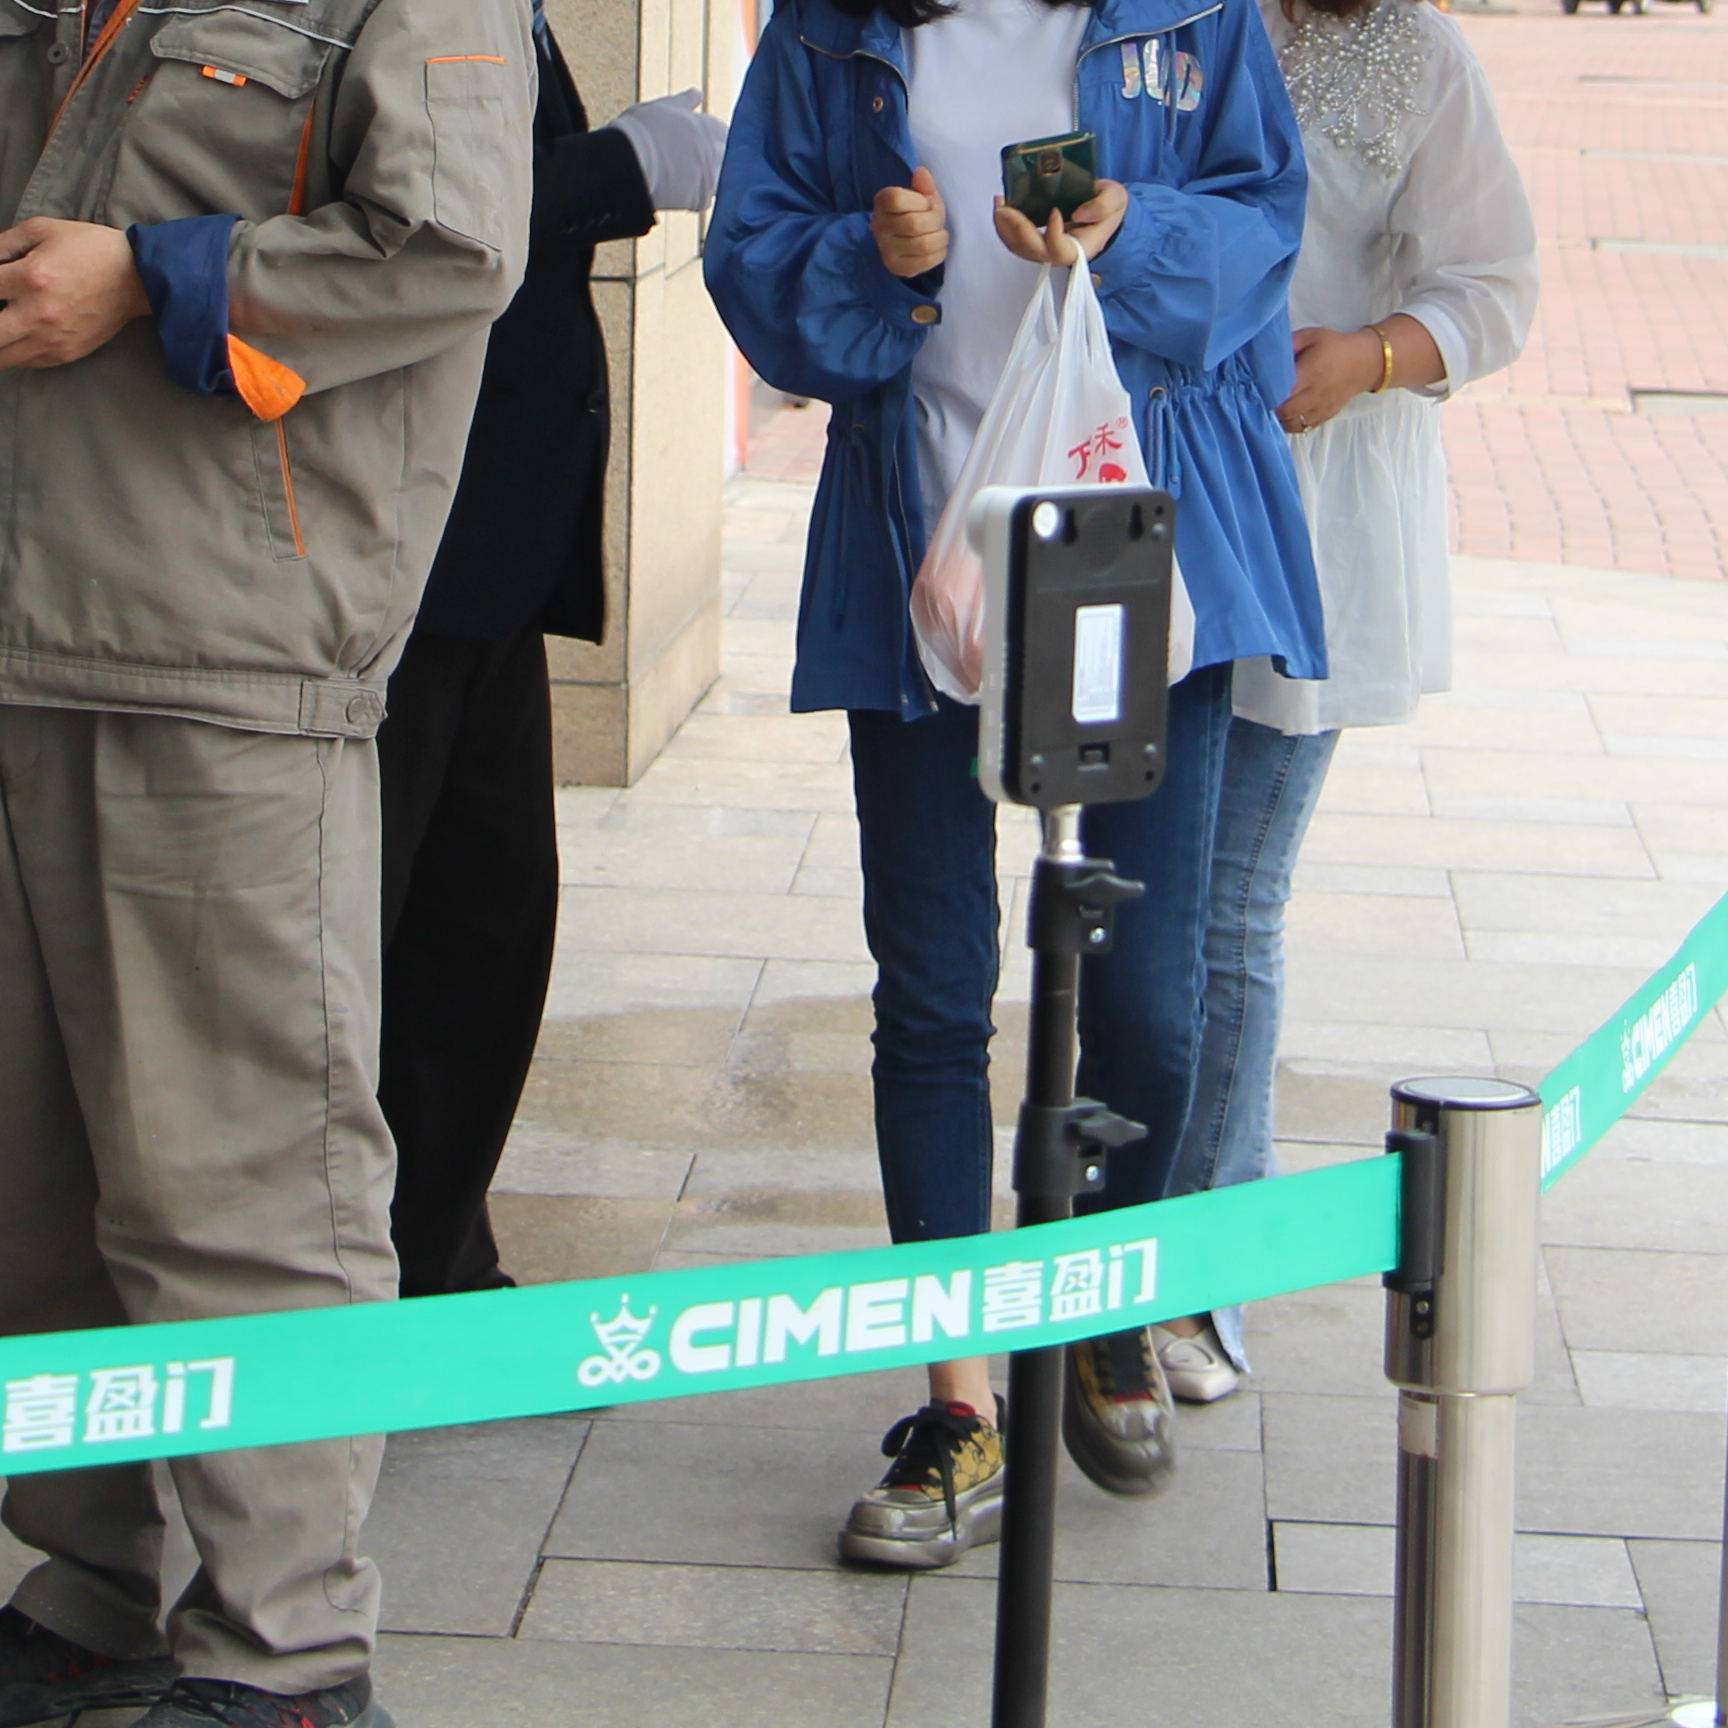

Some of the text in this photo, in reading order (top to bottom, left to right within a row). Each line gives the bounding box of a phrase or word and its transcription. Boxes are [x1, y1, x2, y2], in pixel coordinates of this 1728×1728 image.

[1631, 987, 1671, 1085] CIMEN
[669, 1236, 1159, 1374] CIMEN 喜盈门
[1, 1356, 235, 1454] 喜盈门
